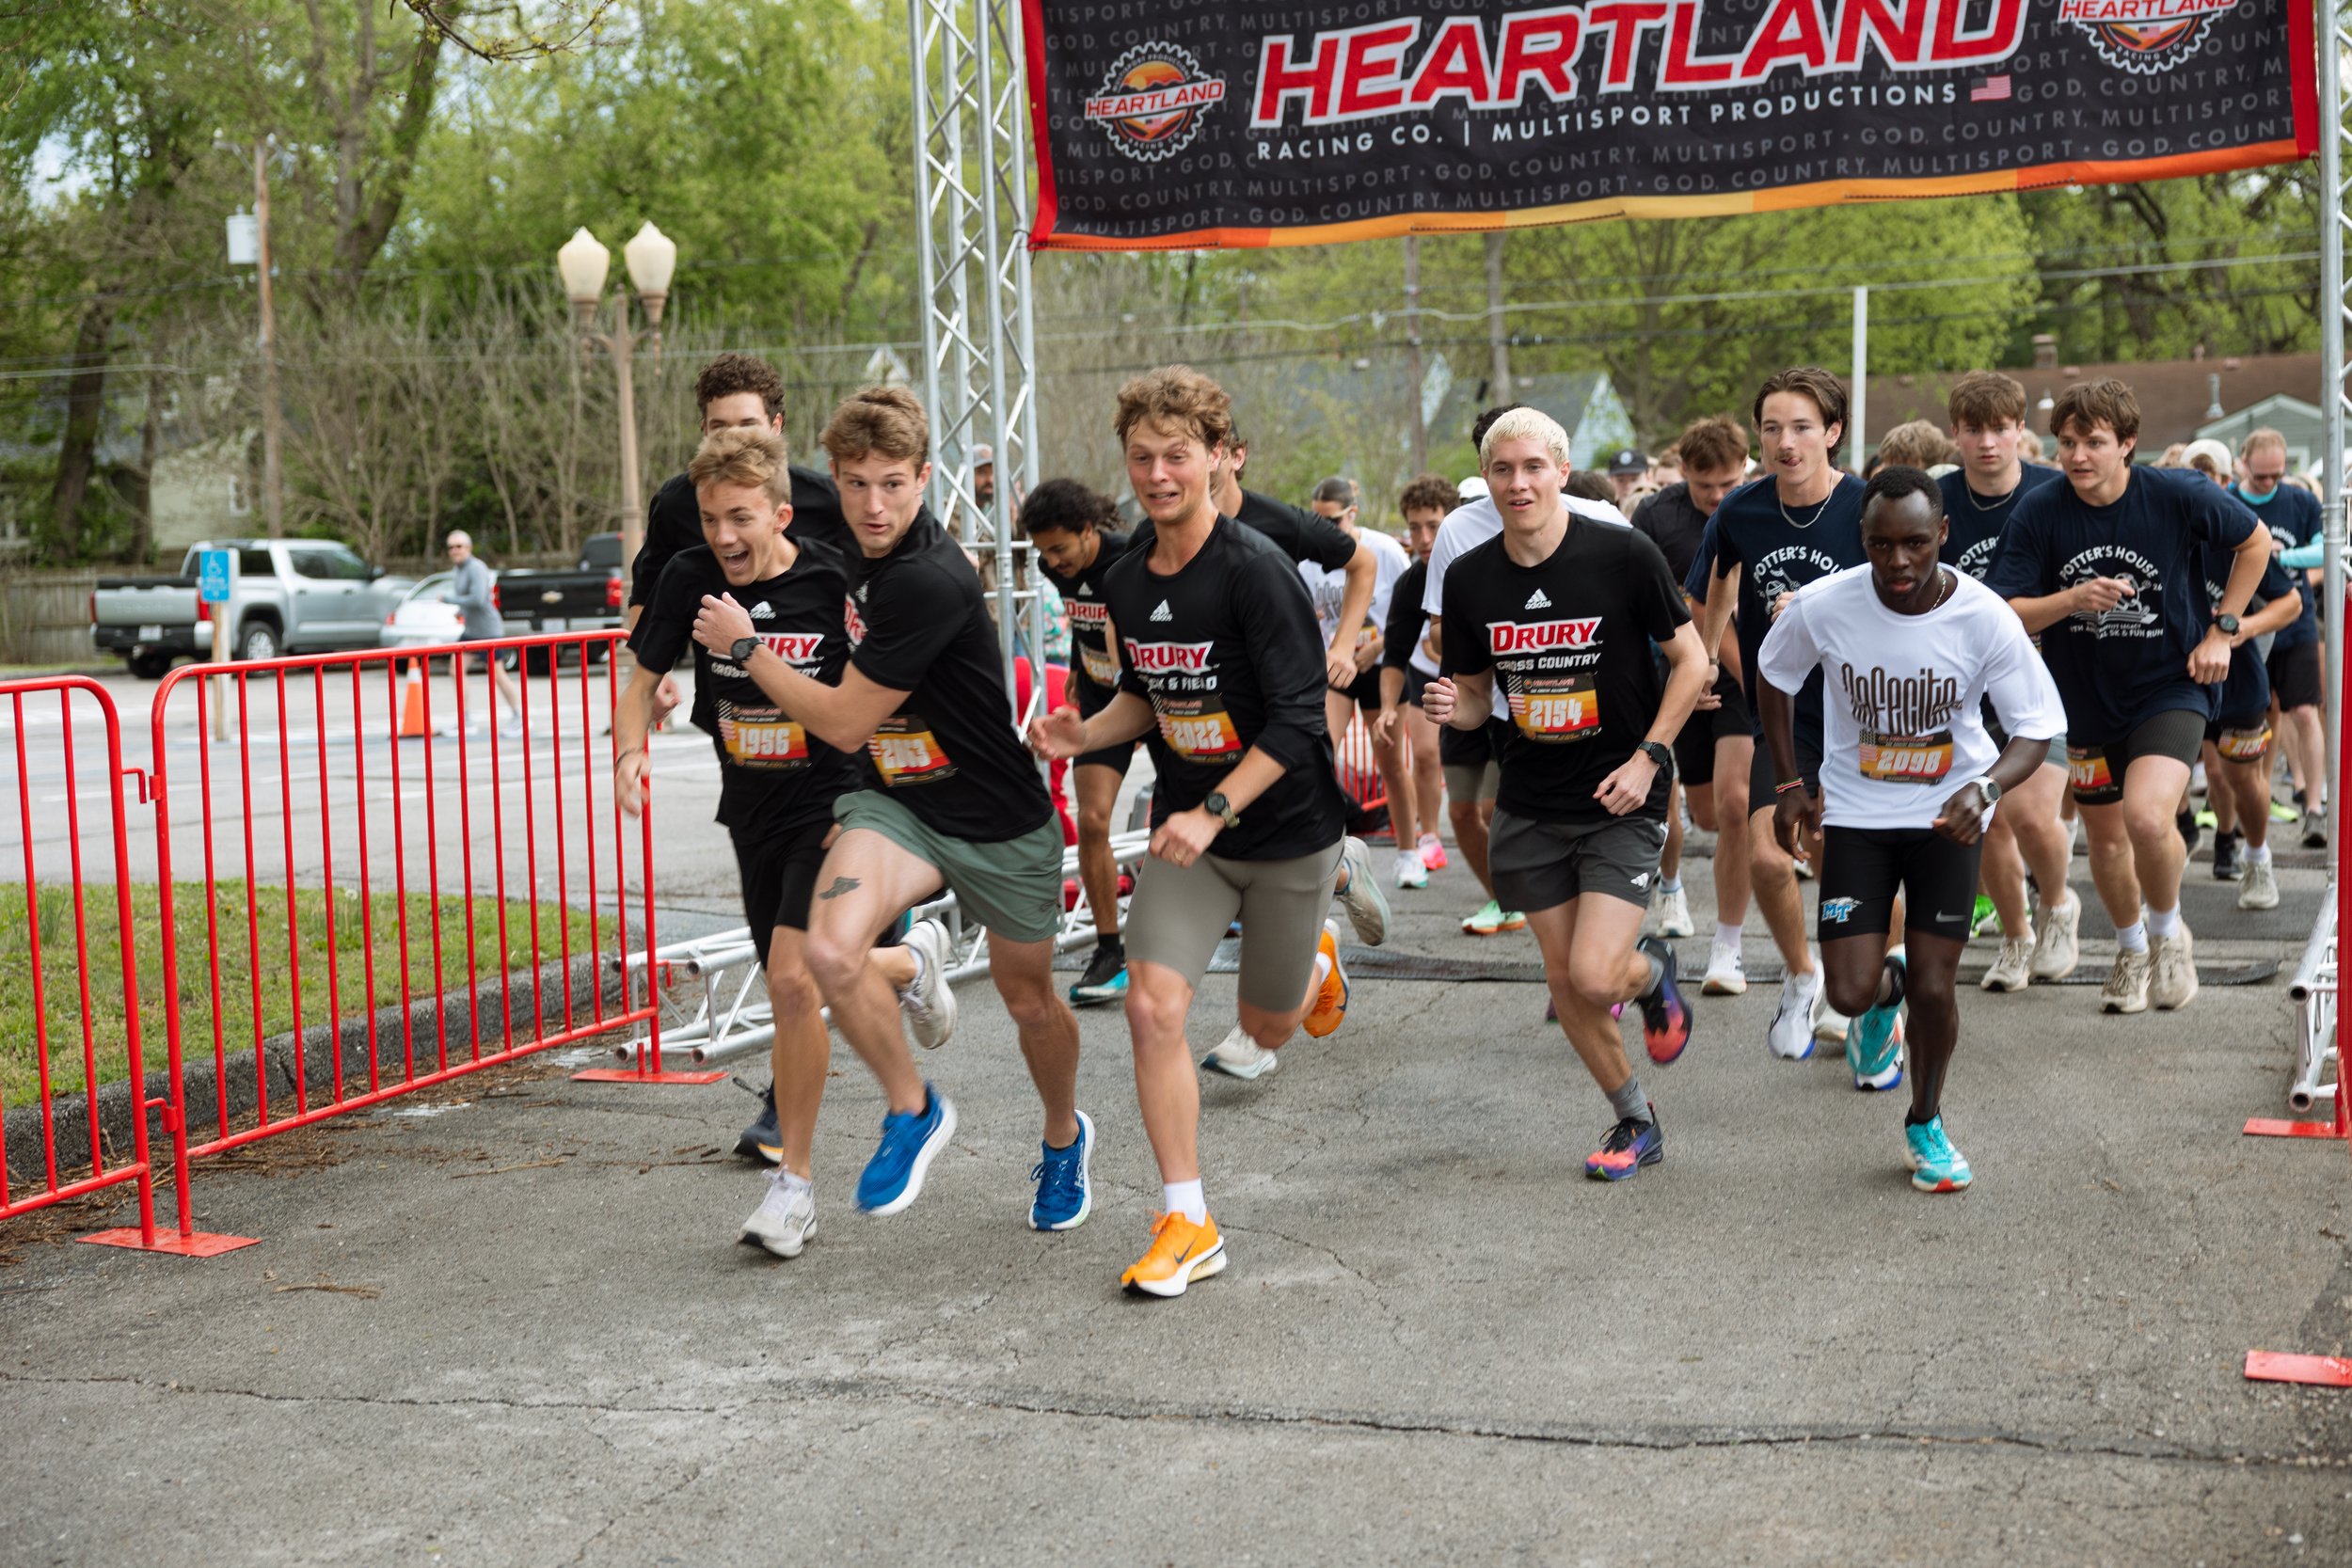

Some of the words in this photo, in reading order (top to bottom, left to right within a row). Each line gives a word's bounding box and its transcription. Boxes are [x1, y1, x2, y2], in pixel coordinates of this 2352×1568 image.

[1250, 0, 2029, 129] HEARTLAND
[1086, 81, 1224, 117] HEARTLAND
[1258, 133, 1375, 161] RACING
[1391, 123, 1443, 145] CO.
[1491, 105, 1691, 143] MULTISPORT
[1710, 83, 1957, 123] PRODUCTIONS
[1248, 165, 1410, 197] MULTISPORT
[1652, 130, 1833, 164] MULTISPORT
[2102, 87, 2280, 128] MULTISPOR
[1455, 175, 1628, 209] MULTISPORT
[1883, 139, 2073, 176] MULTISPORT
[2187, 116, 2295, 150] COUNT
[2059, 545, 2113, 581] POTTER'S
[2115, 546, 2159, 578] HOUSE
[1064, 599, 1108, 621] DRUR
[1524, 600, 1552, 610] adidas
[1487, 617, 1601, 656] DRURY
[1537, 653, 1602, 670] COUNTRY
[1528, 698, 1583, 728] 2154
[738, 728, 790, 755] 1956
[1170, 720, 1226, 750] 2022
[1876, 750, 1943, 774] 2098
